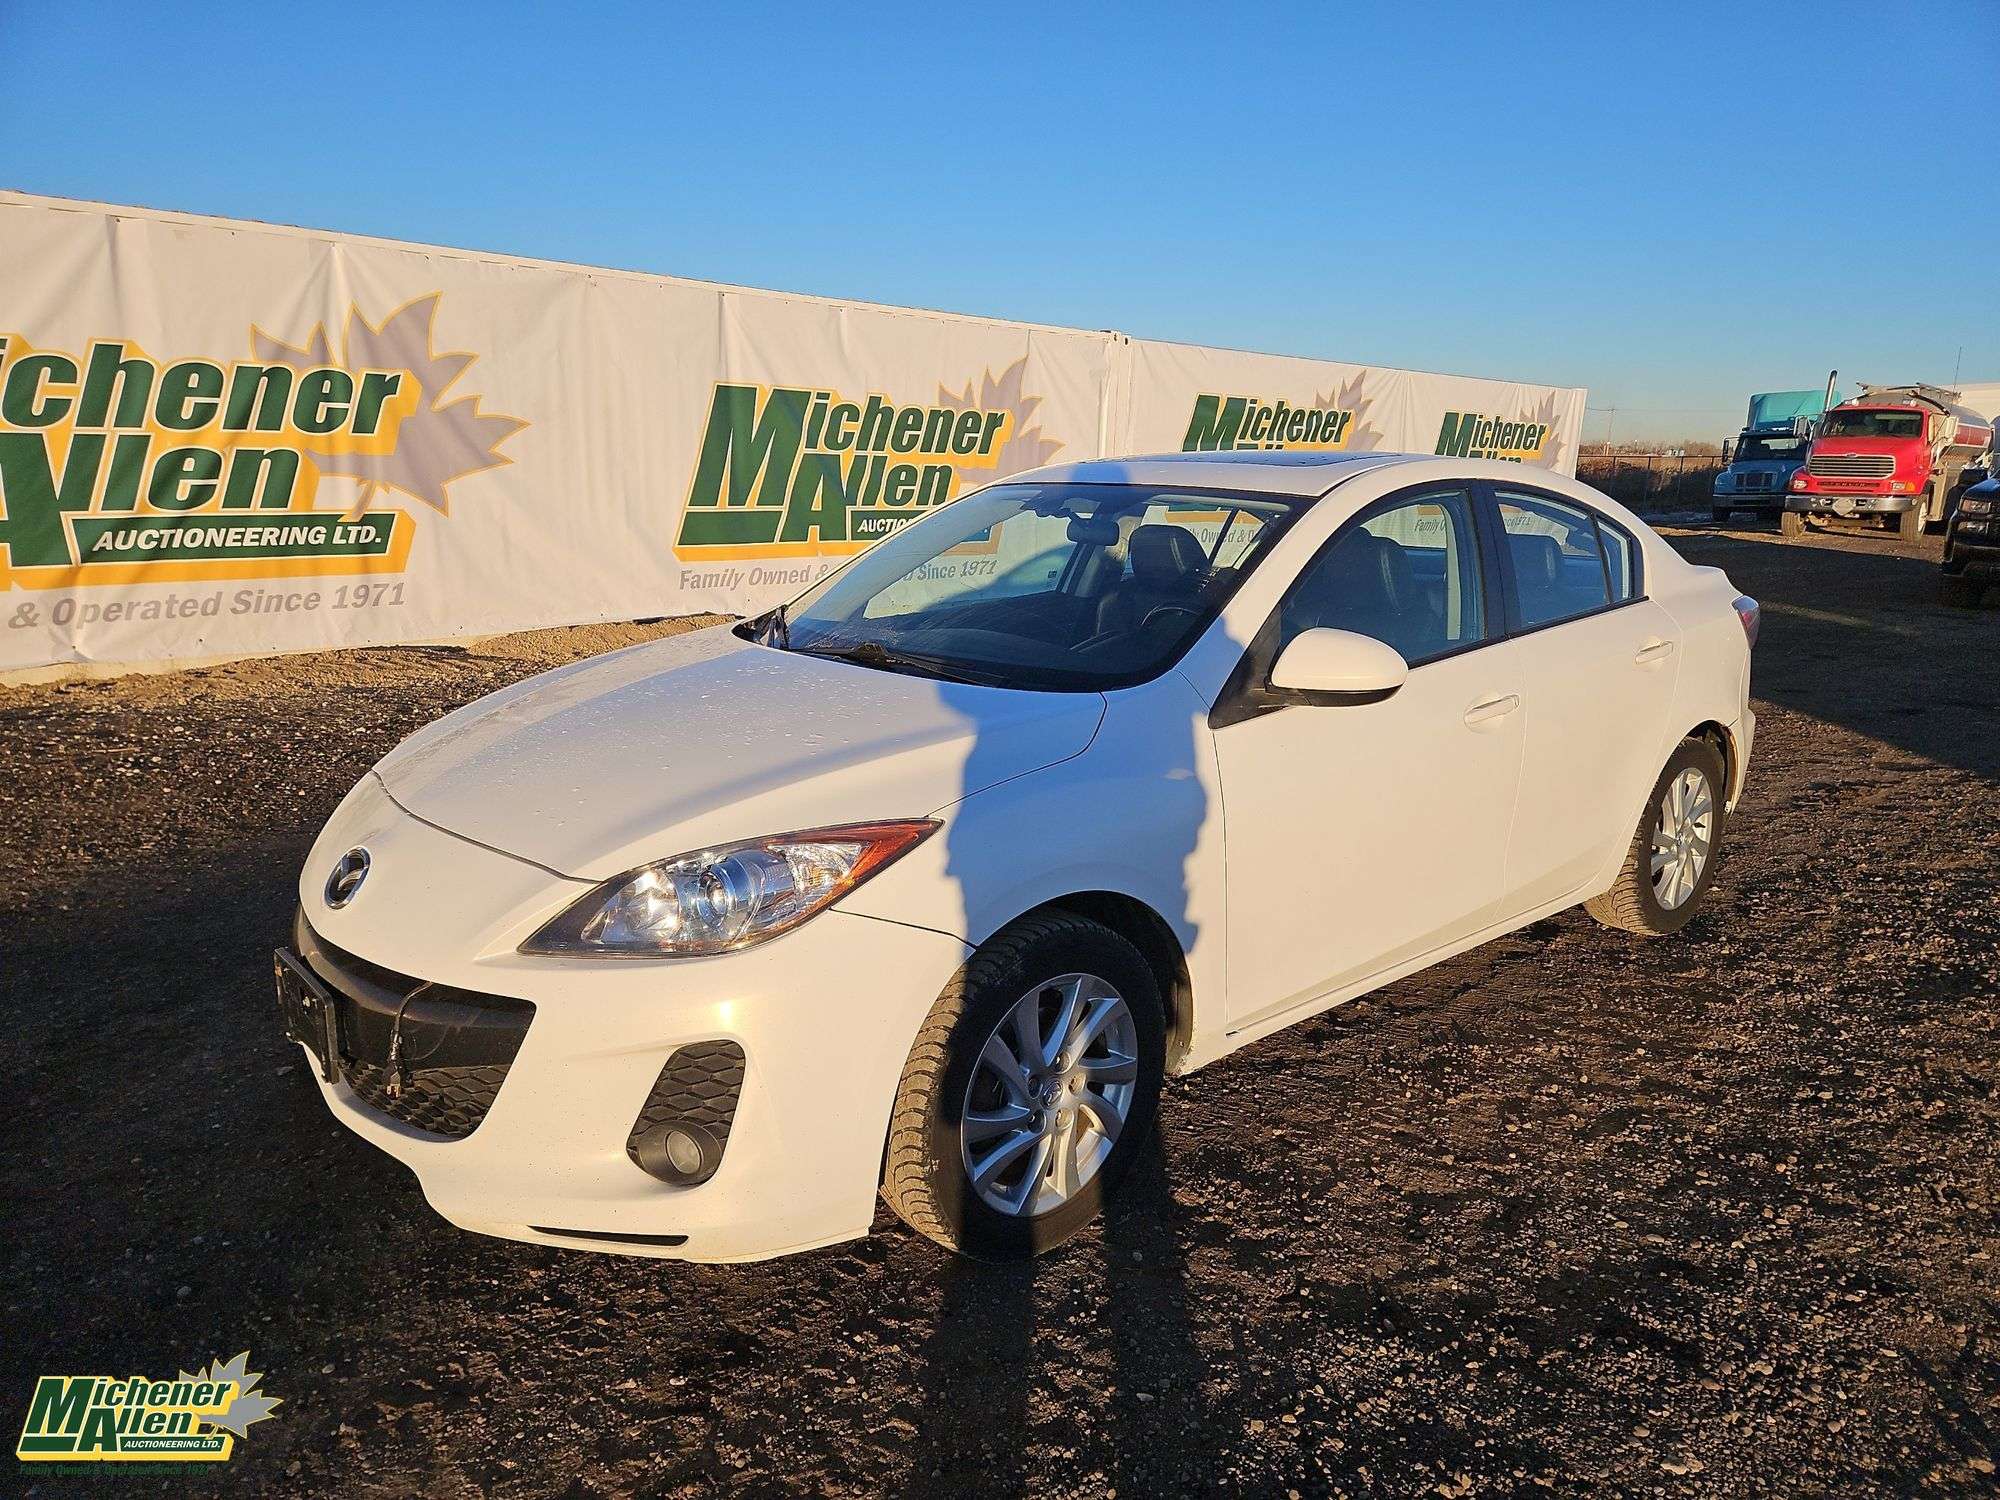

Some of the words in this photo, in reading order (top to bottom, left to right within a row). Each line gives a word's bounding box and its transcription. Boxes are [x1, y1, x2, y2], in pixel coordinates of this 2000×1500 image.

[688, 384, 1005, 507] Michener
[1182, 394, 1351, 452] Michener
[1434, 411, 1547, 458] Michener
[778, 453, 952, 542] Allen
[92, 525, 326, 551] AUCTIONEERING
[331, 525, 382, 545] LTD.
[1201, 527, 1236, 543] Owd
[679, 568, 744, 591] Family
[749, 564, 812, 586] Owned
[917, 562, 957, 582] Since
[960, 560, 998, 578] 1971
[8, 602, 40, 629] &
[52, 590, 224, 630] Operated
[230, 589, 321, 615] Since
[331, 582, 405, 610] 1971
